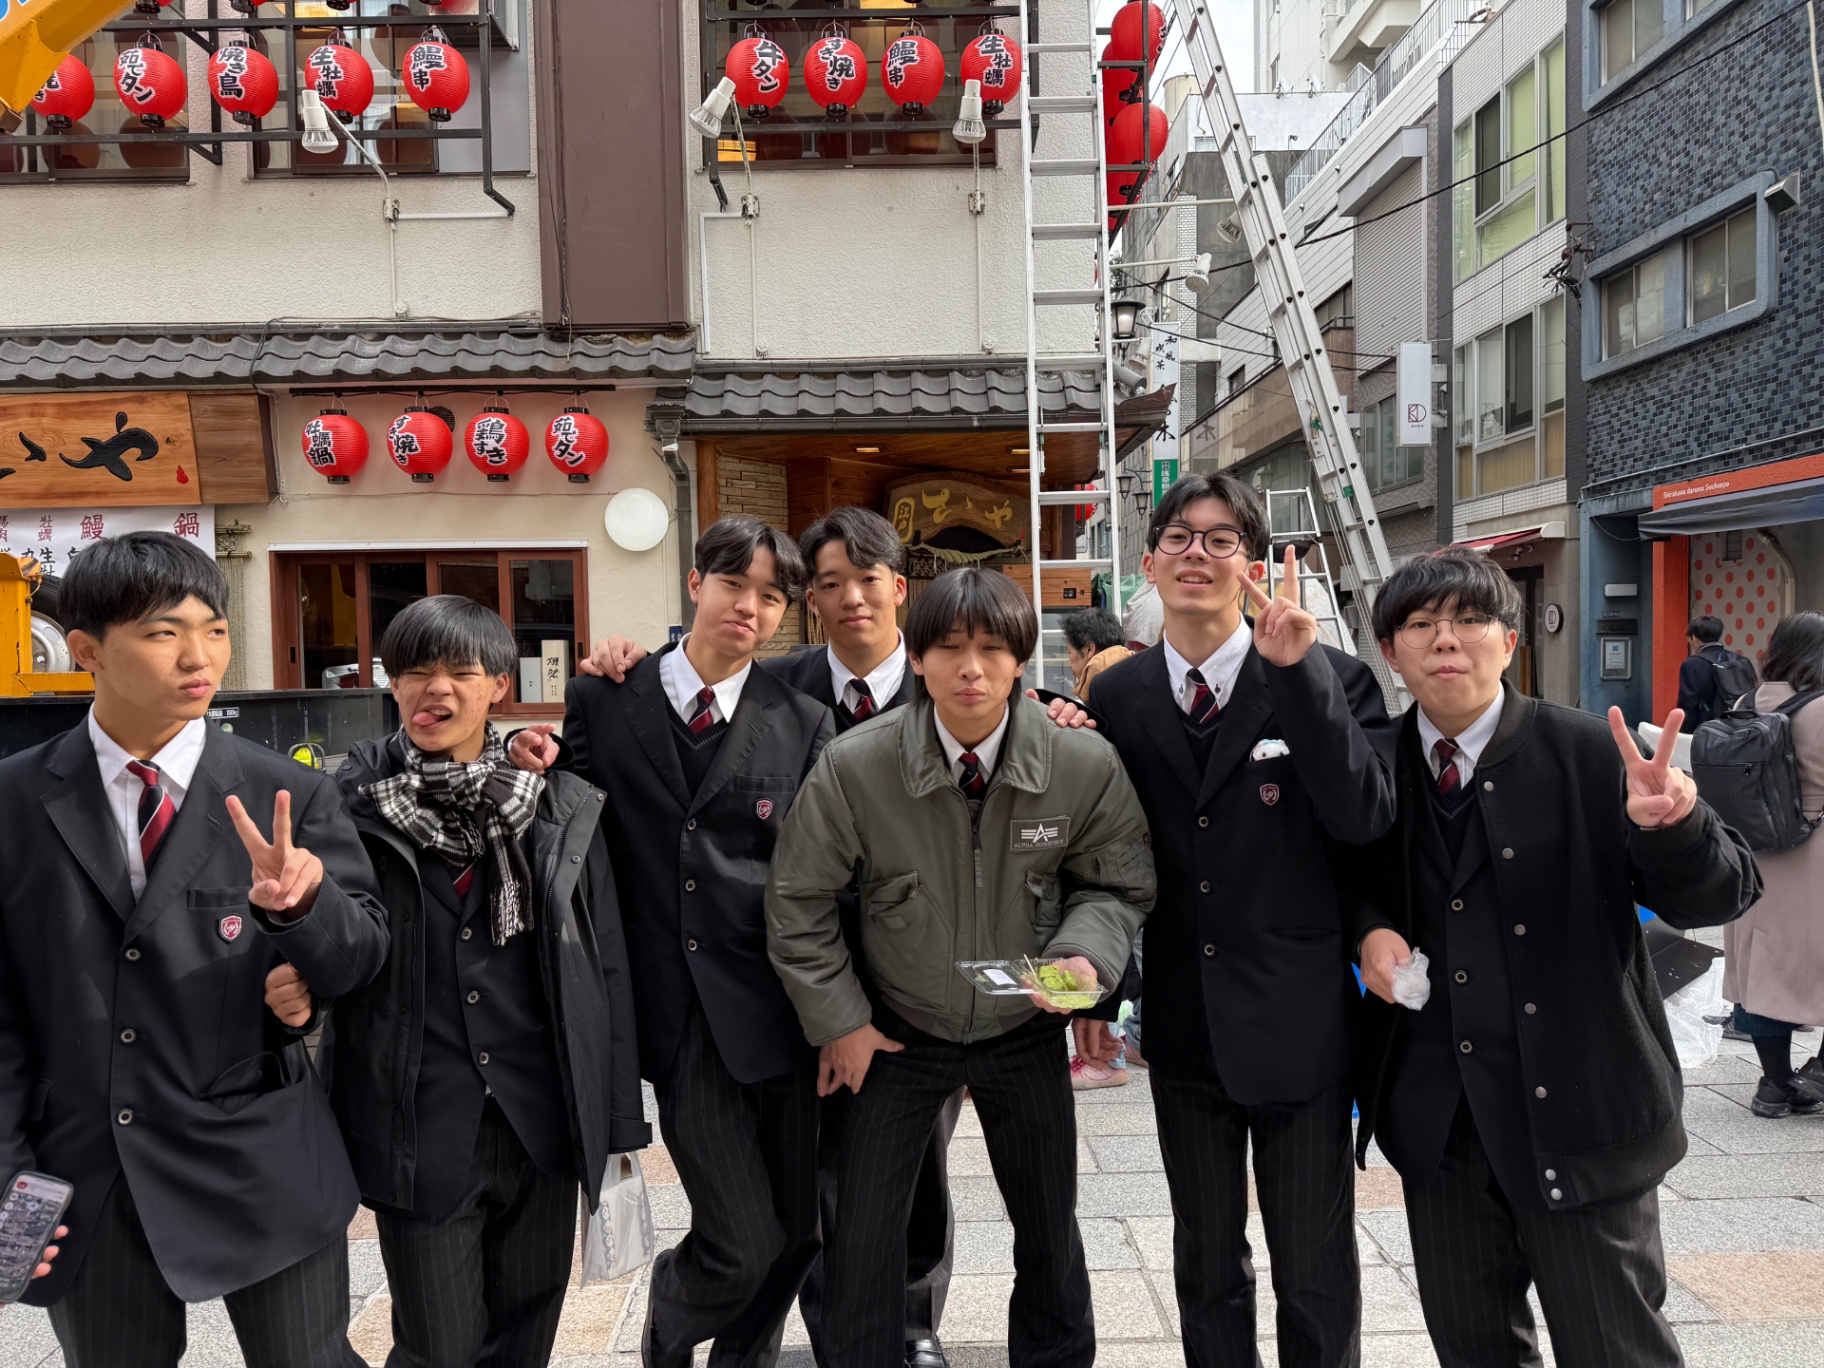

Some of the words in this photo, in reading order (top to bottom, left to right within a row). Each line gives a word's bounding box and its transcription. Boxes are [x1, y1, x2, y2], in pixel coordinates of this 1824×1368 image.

[119, 50, 153, 102] 茹でタン
[218, 47, 246, 98] 焼き鳥
[310, 47, 343, 97] 生牡蠣
[411, 45, 446, 90] 鰻串
[752, 40, 784, 91] 牛タン
[819, 38, 855, 90] すき焼き
[887, 41, 919, 87] 鰻串
[976, 36, 1012, 87] 生牡蠣
[305, 420, 335, 466] 牡蠣鍋
[388, 416, 420, 465] すき焼き
[474, 417, 507, 464] 鶏すき
[553, 416, 584, 466] 茹でタン
[1663, 490, 1686, 498] Shirakawa
[1687, 486, 1704, 494] daruma
[37, 514, 54, 543] 牡蠣
[79, 514, 104, 540] 鰻
[173, 512, 200, 538] 鍋
